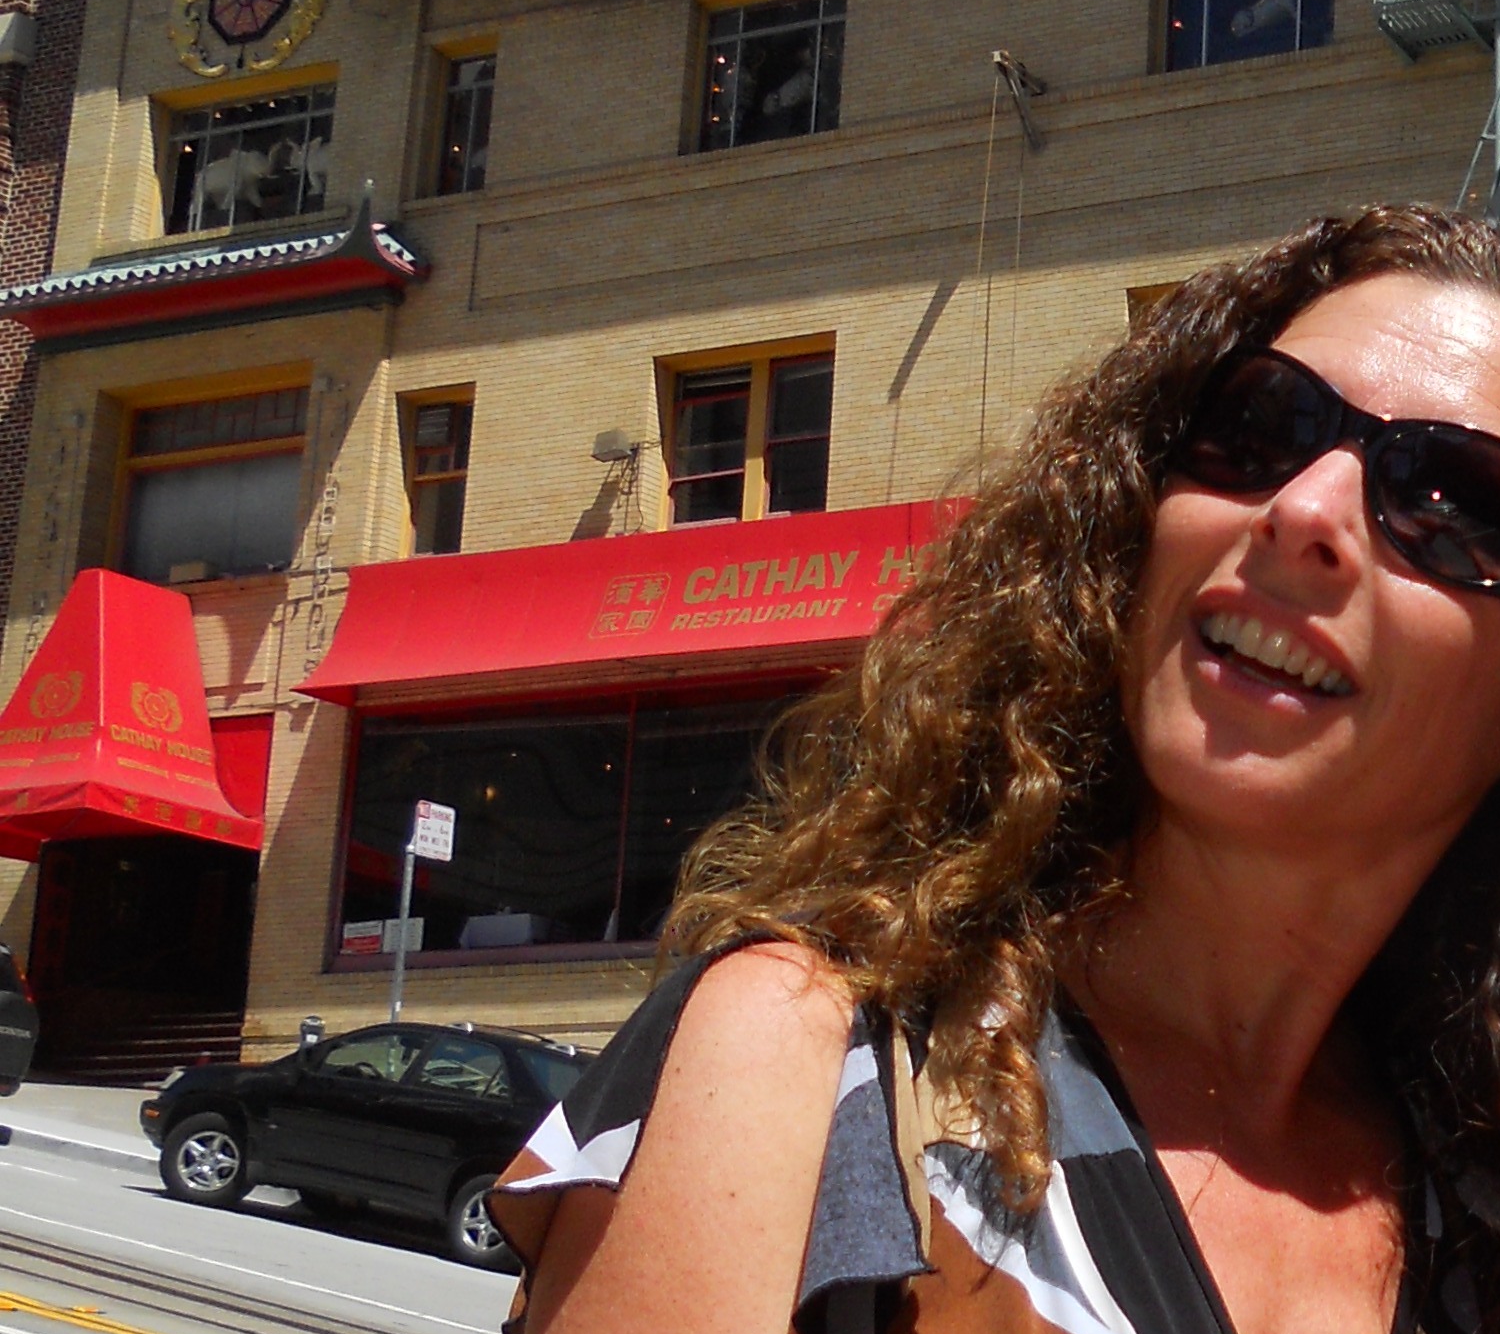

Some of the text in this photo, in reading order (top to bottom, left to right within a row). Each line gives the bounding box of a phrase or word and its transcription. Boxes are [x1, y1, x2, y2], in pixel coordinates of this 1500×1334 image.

[683, 550, 860, 605] CATHAY
[671, 598, 847, 631] RESTAURANT
[110, 723, 213, 767] CATHAY HOUSE
